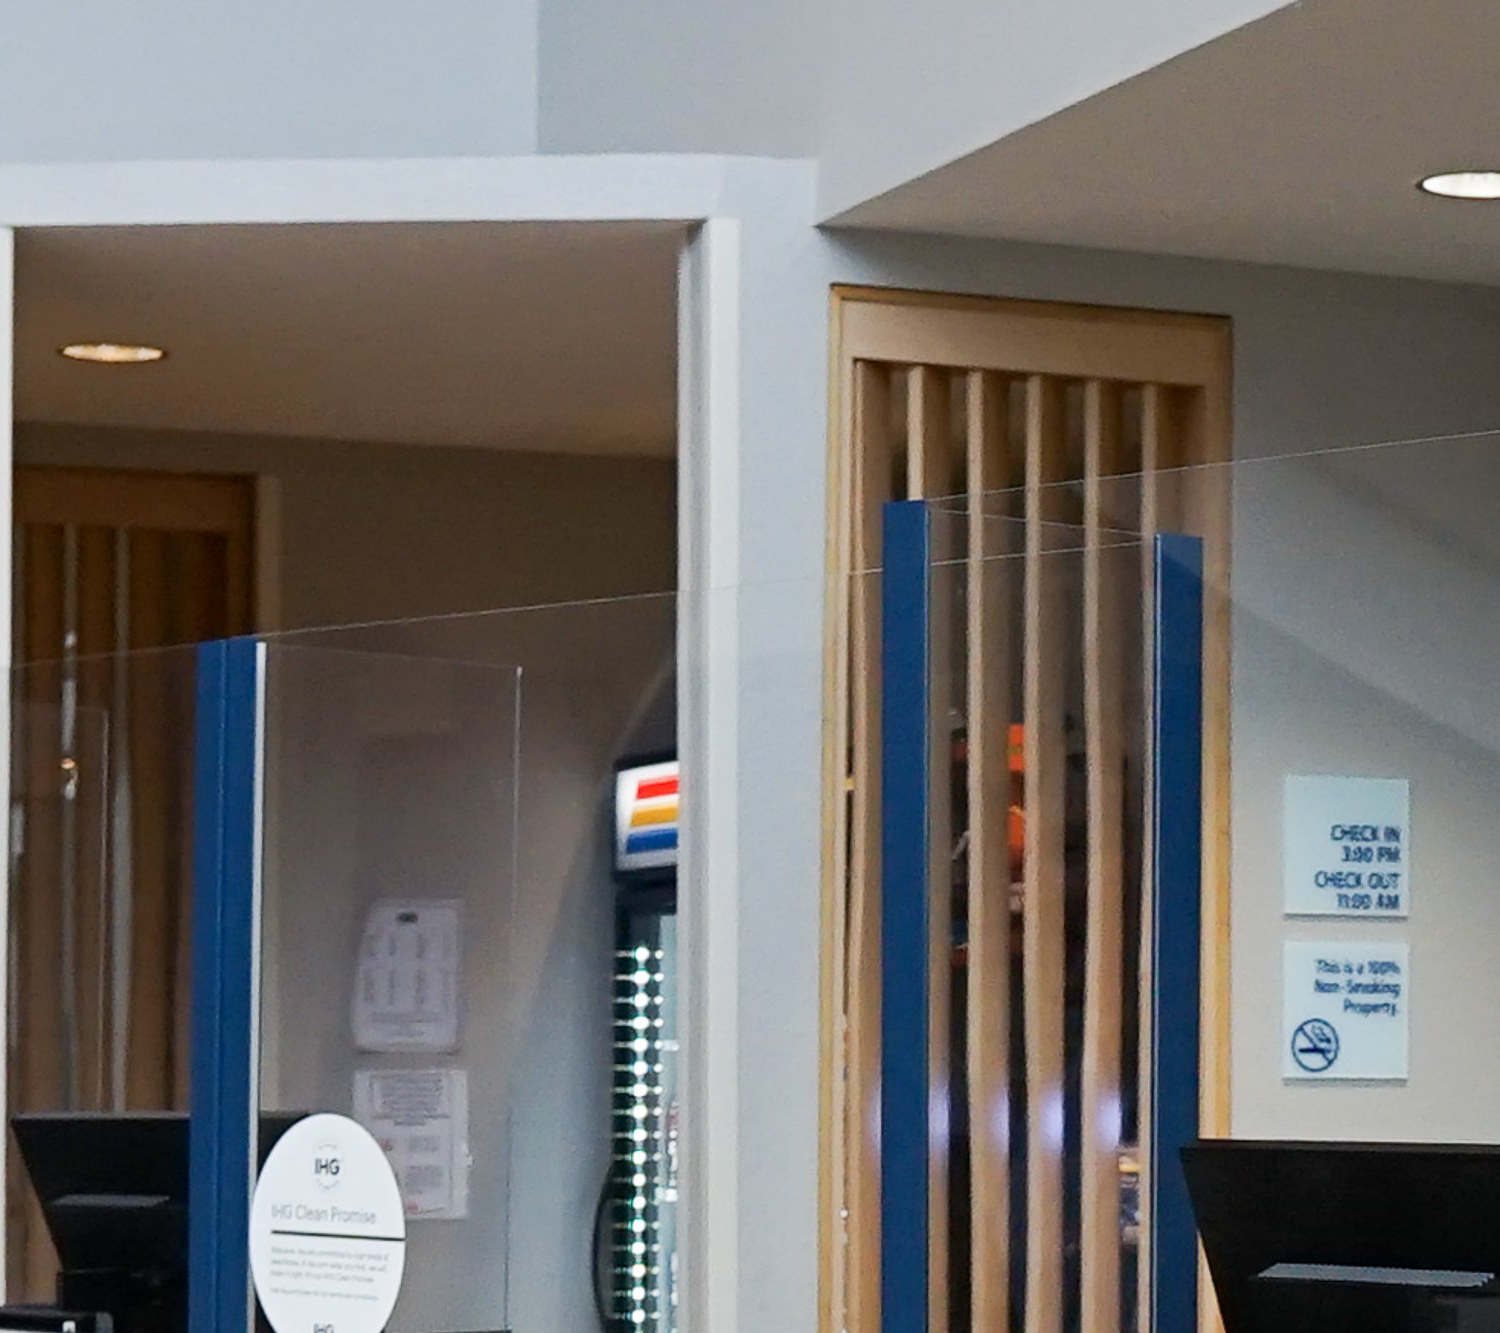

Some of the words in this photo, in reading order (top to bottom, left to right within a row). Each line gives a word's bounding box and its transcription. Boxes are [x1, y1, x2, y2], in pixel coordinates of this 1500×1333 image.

[1330, 824, 1378, 842] CHECK
[1383, 826, 1401, 842] IN
[1376, 847, 1401, 863] PM
[1314, 871, 1364, 889] CHECK
[1368, 872, 1401, 890] OUT
[1375, 894, 1400, 910] AM
[1315, 959, 1341, 975] This
[1344, 960, 1354, 975] is
[315, 1158, 340, 1176] IHG
[271, 1204, 293, 1219] IHG
[295, 1205, 328, 1222] Clean
[331, 1206, 377, 1225] Promise
